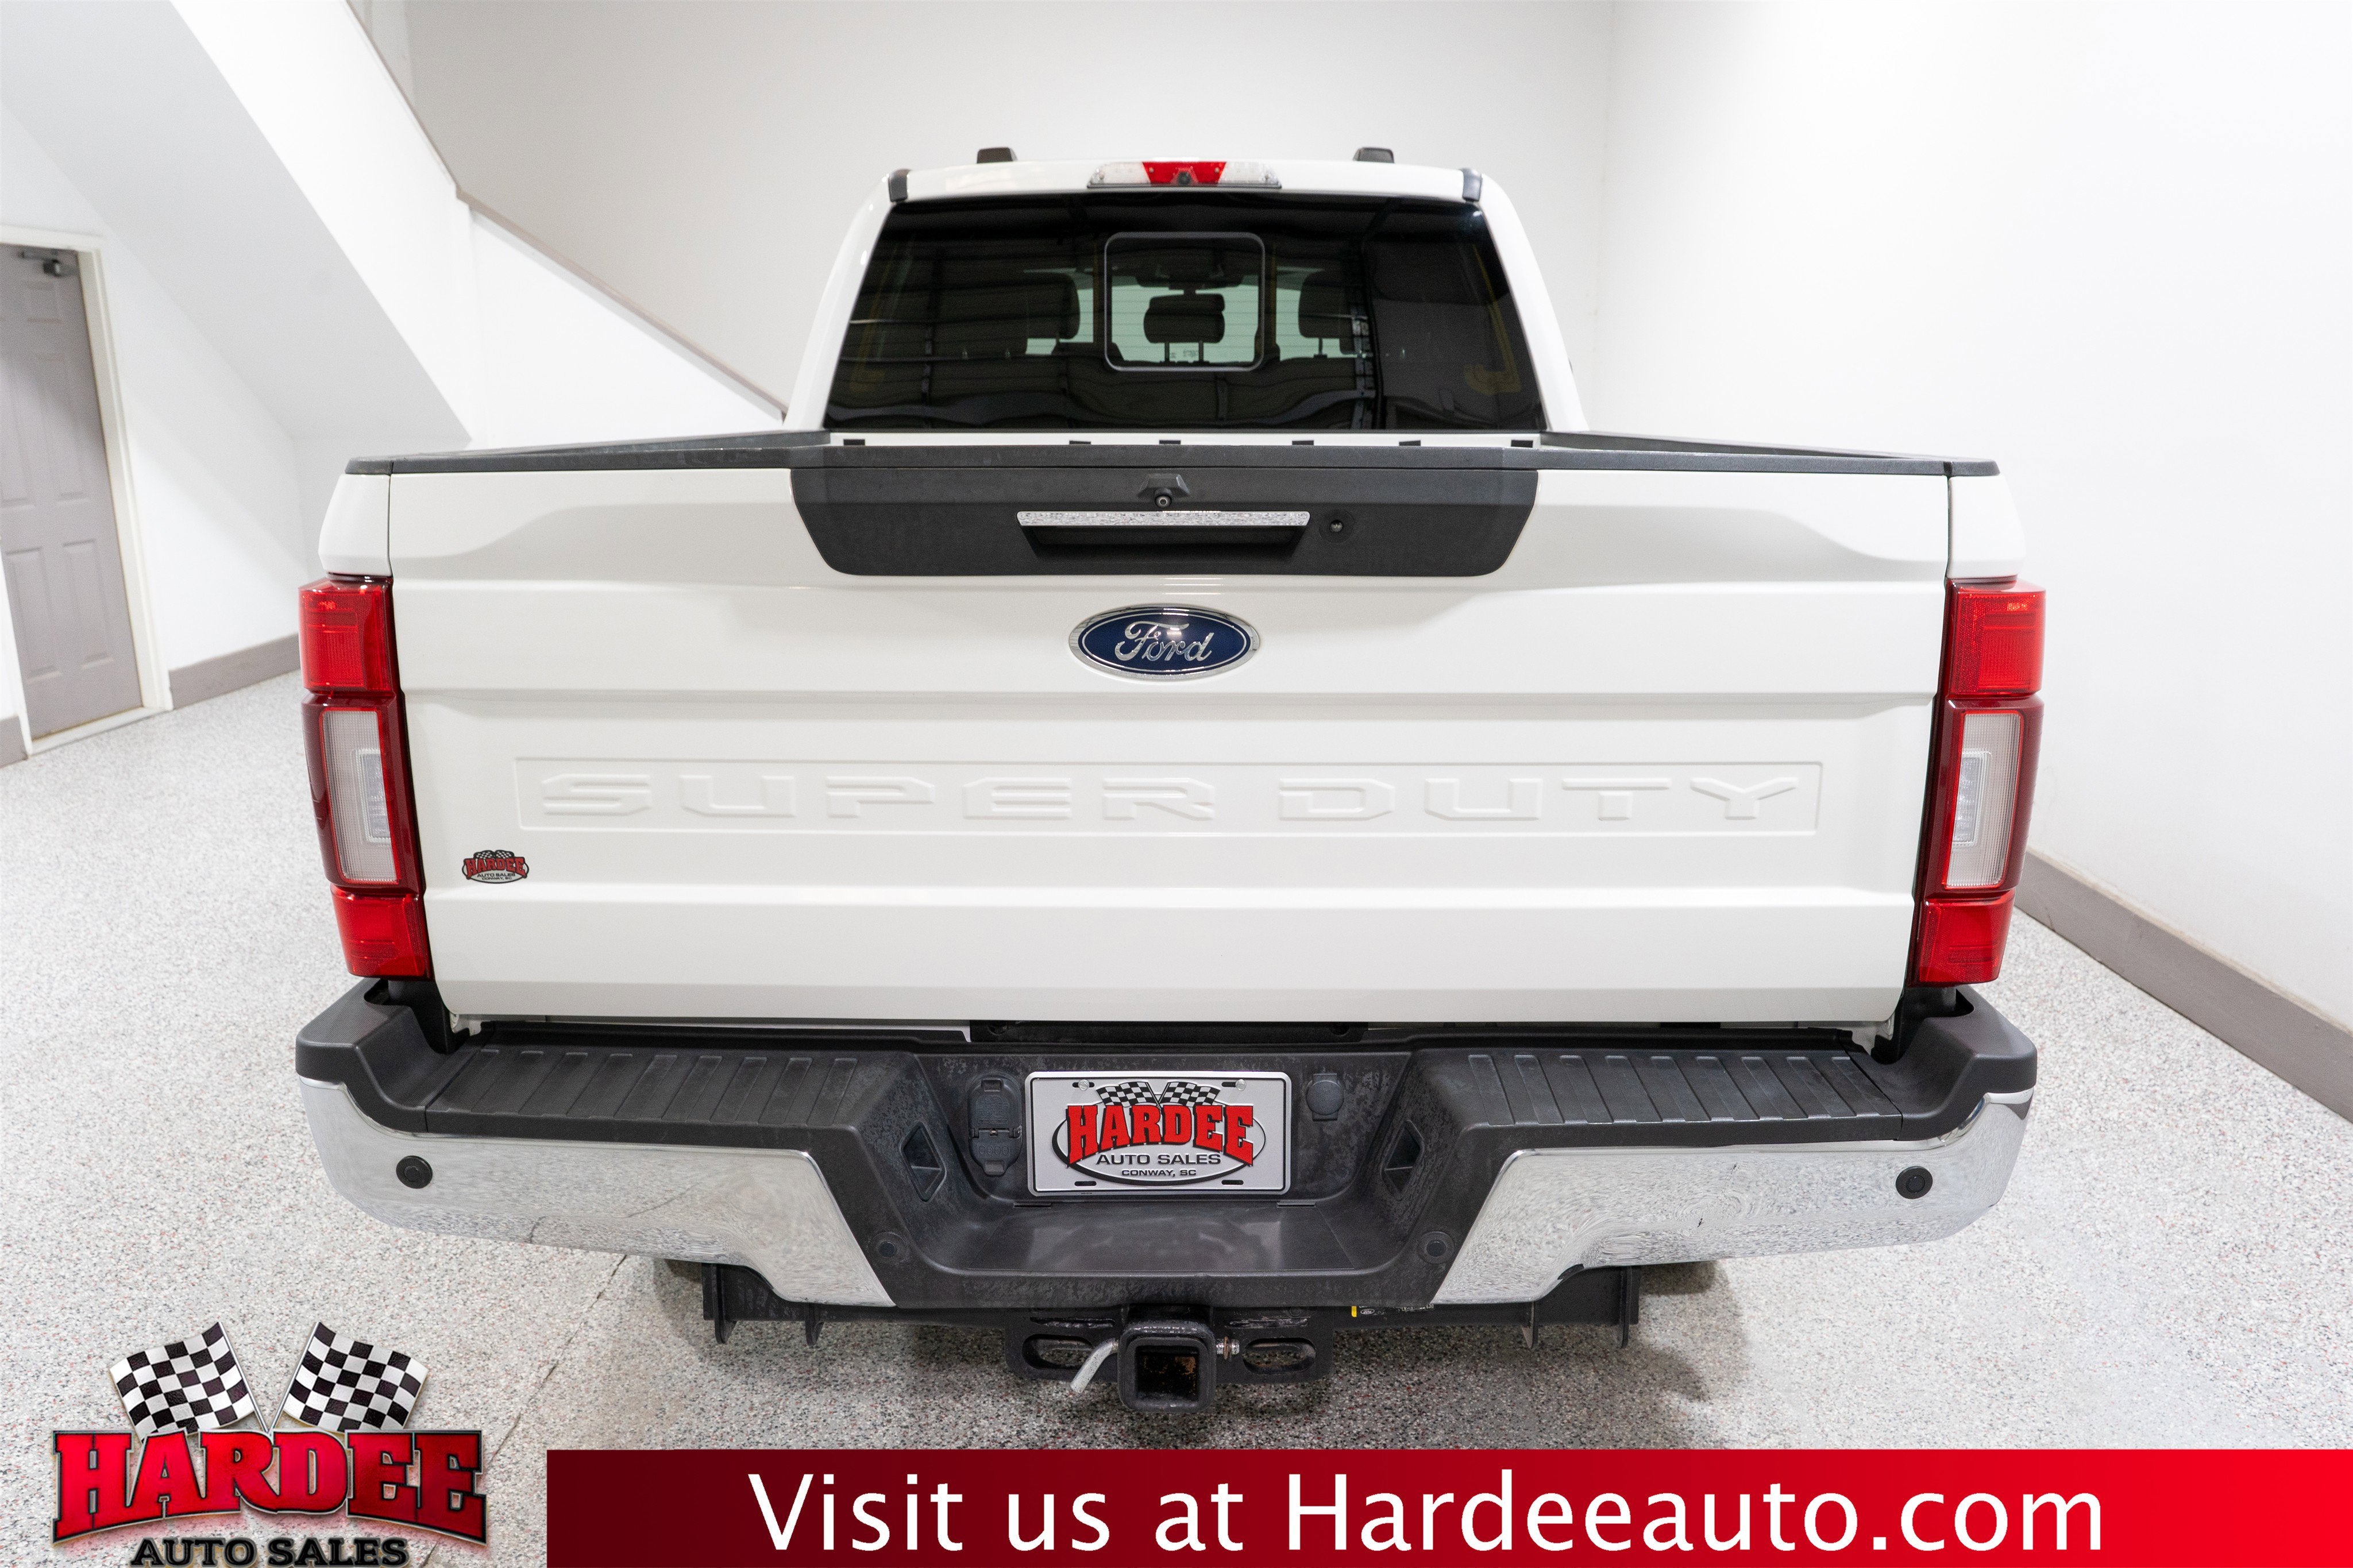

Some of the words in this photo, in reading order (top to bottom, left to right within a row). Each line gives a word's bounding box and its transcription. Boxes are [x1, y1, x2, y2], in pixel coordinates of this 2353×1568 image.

[1114, 621, 1214, 662] Ford
[541, 774, 1215, 821] SUPER
[1278, 778, 1799, 821] DUTY
[465, 857, 526, 879] HARDEE
[1066, 1104, 1253, 1167] HARDEE
[1096, 1154, 1150, 1165] AUTO
[1158, 1154, 1221, 1165] SALES
[1121, 1169, 1176, 1177] CONWAY,
